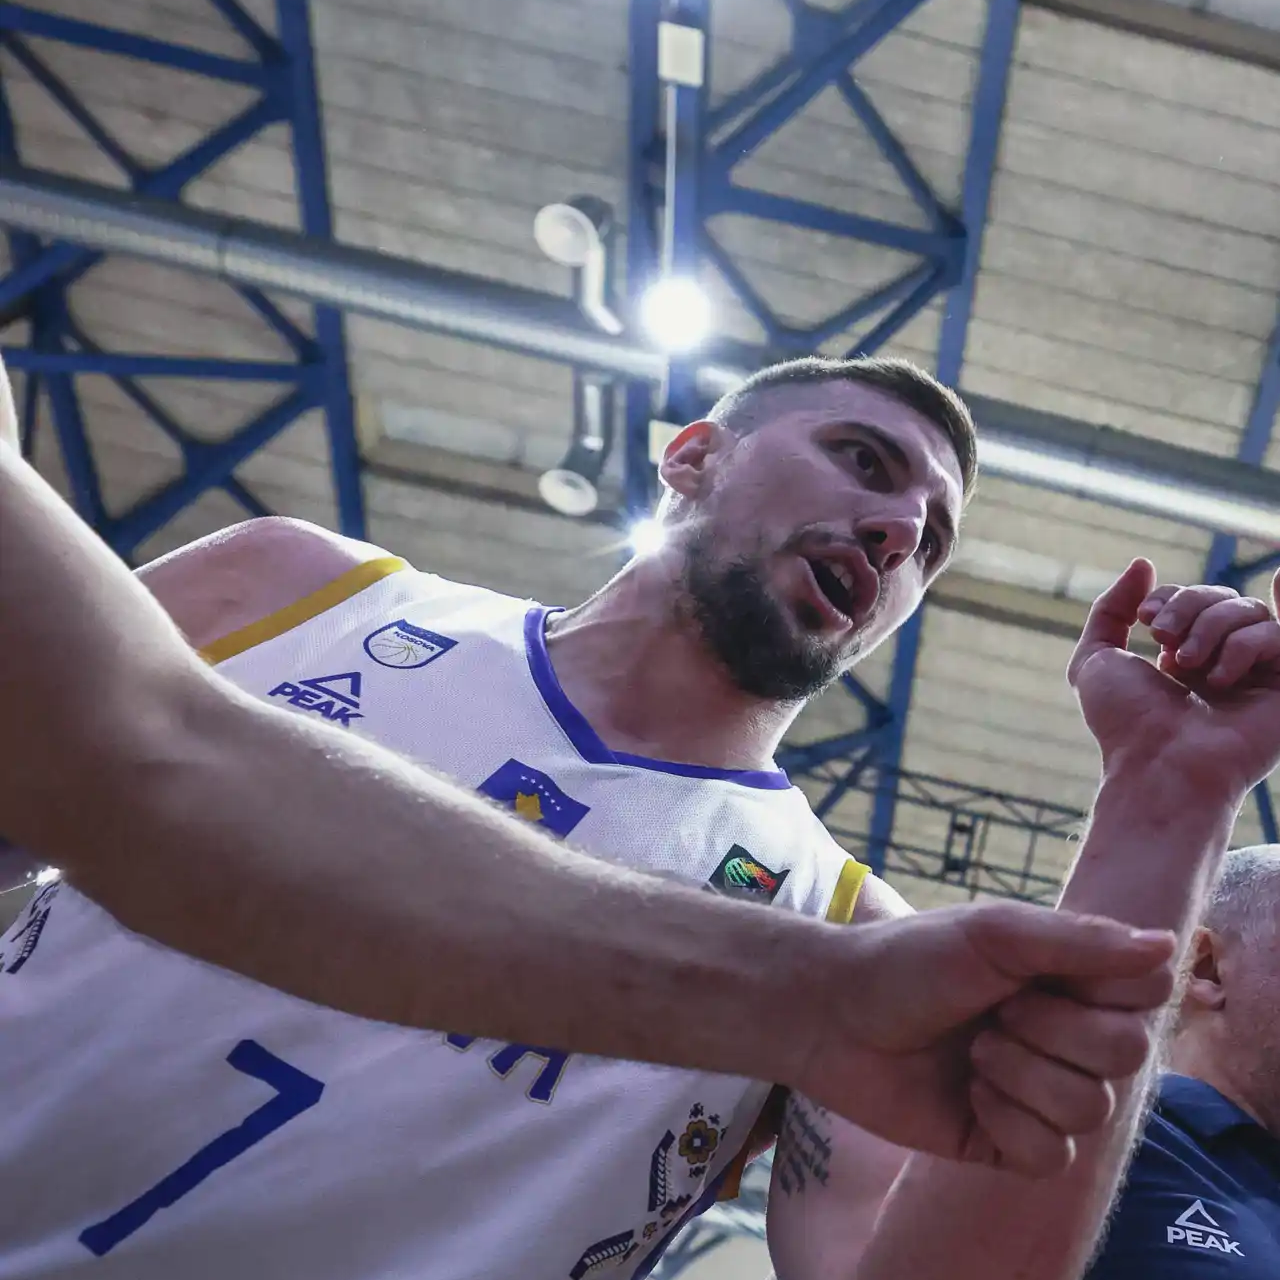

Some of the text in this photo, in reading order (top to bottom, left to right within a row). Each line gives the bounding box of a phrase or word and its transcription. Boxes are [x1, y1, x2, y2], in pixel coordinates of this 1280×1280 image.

[267, 681, 365, 729] PEAK
[78, 1039, 325, 1257] 7
[1166, 1225, 1246, 1257] PEAK
